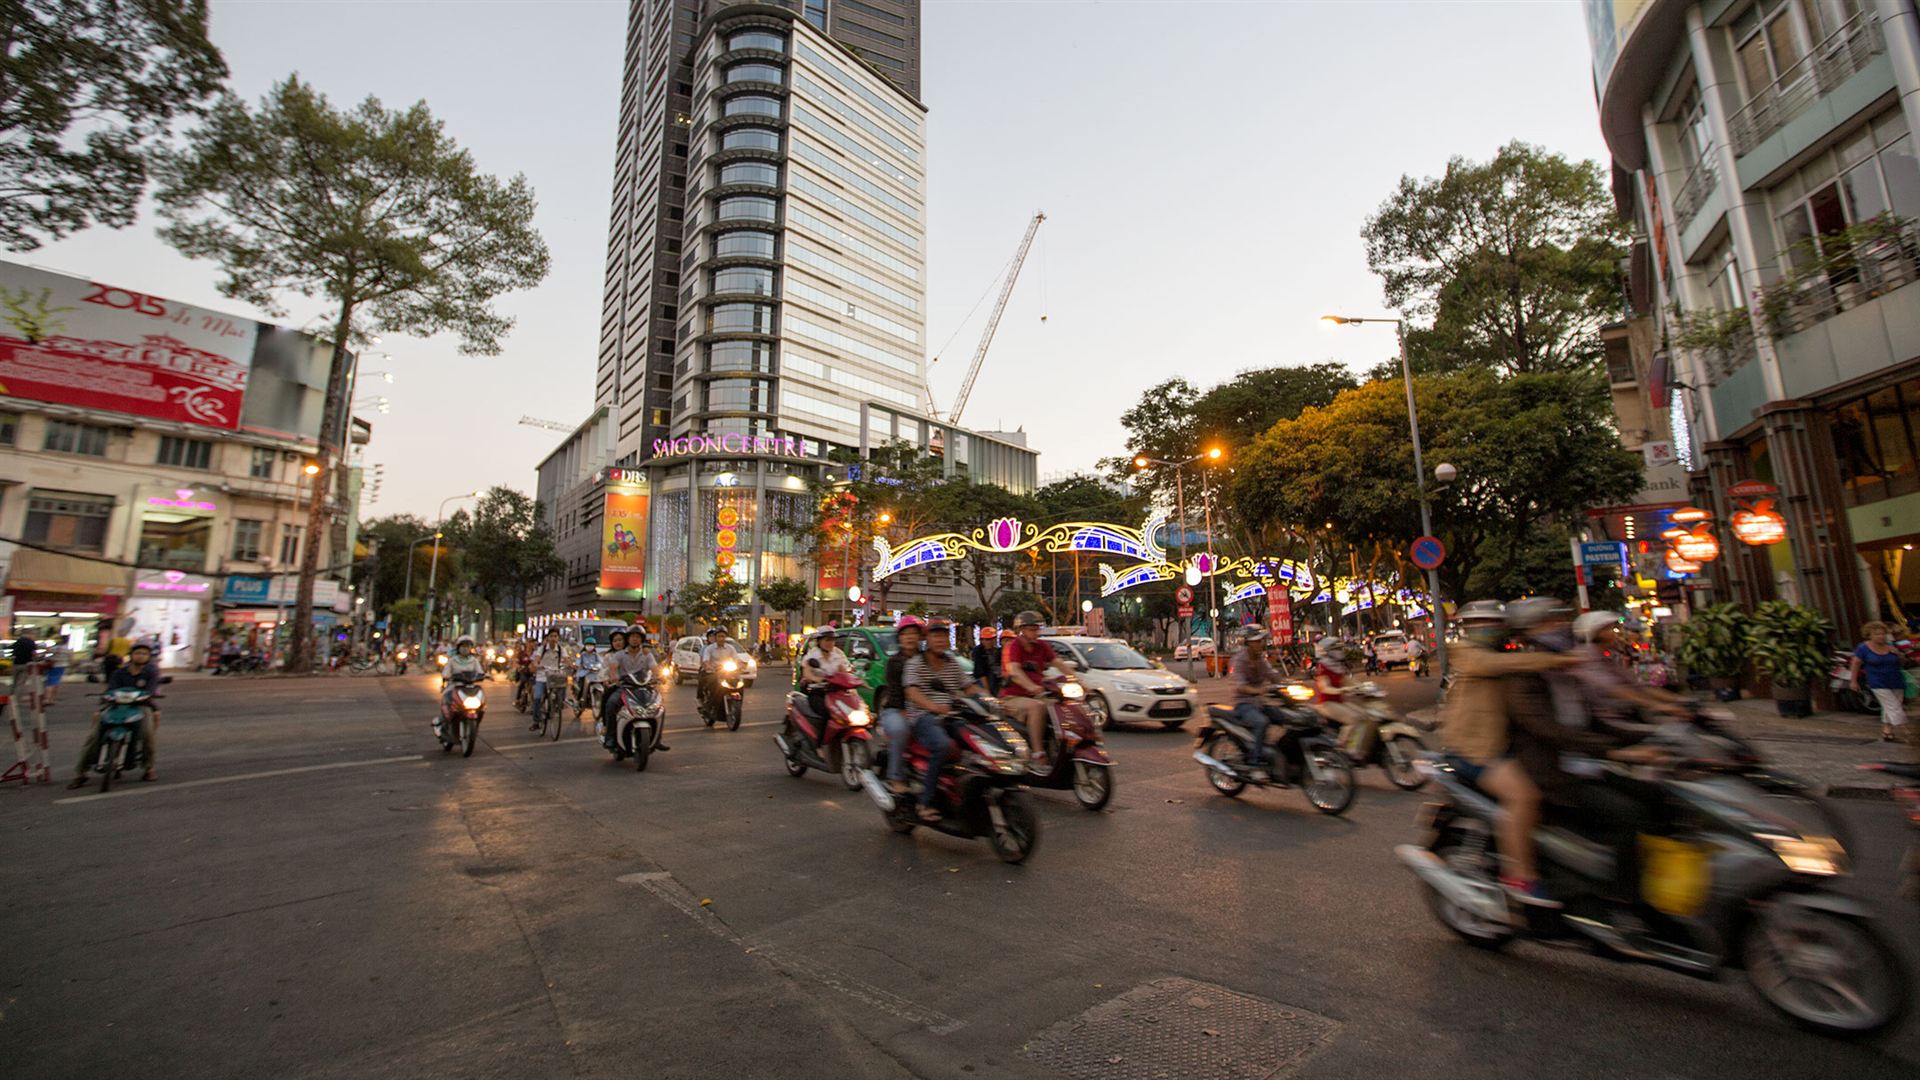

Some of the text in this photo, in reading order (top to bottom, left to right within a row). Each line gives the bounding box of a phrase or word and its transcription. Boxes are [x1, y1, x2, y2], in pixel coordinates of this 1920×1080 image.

[80, 281, 167, 318] 2015
[621, 469, 647, 483] DBS
[714, 475, 741, 487] AG
[1585, 553, 1621, 562] PASTEUR
[233, 580, 263, 593] PLUS
